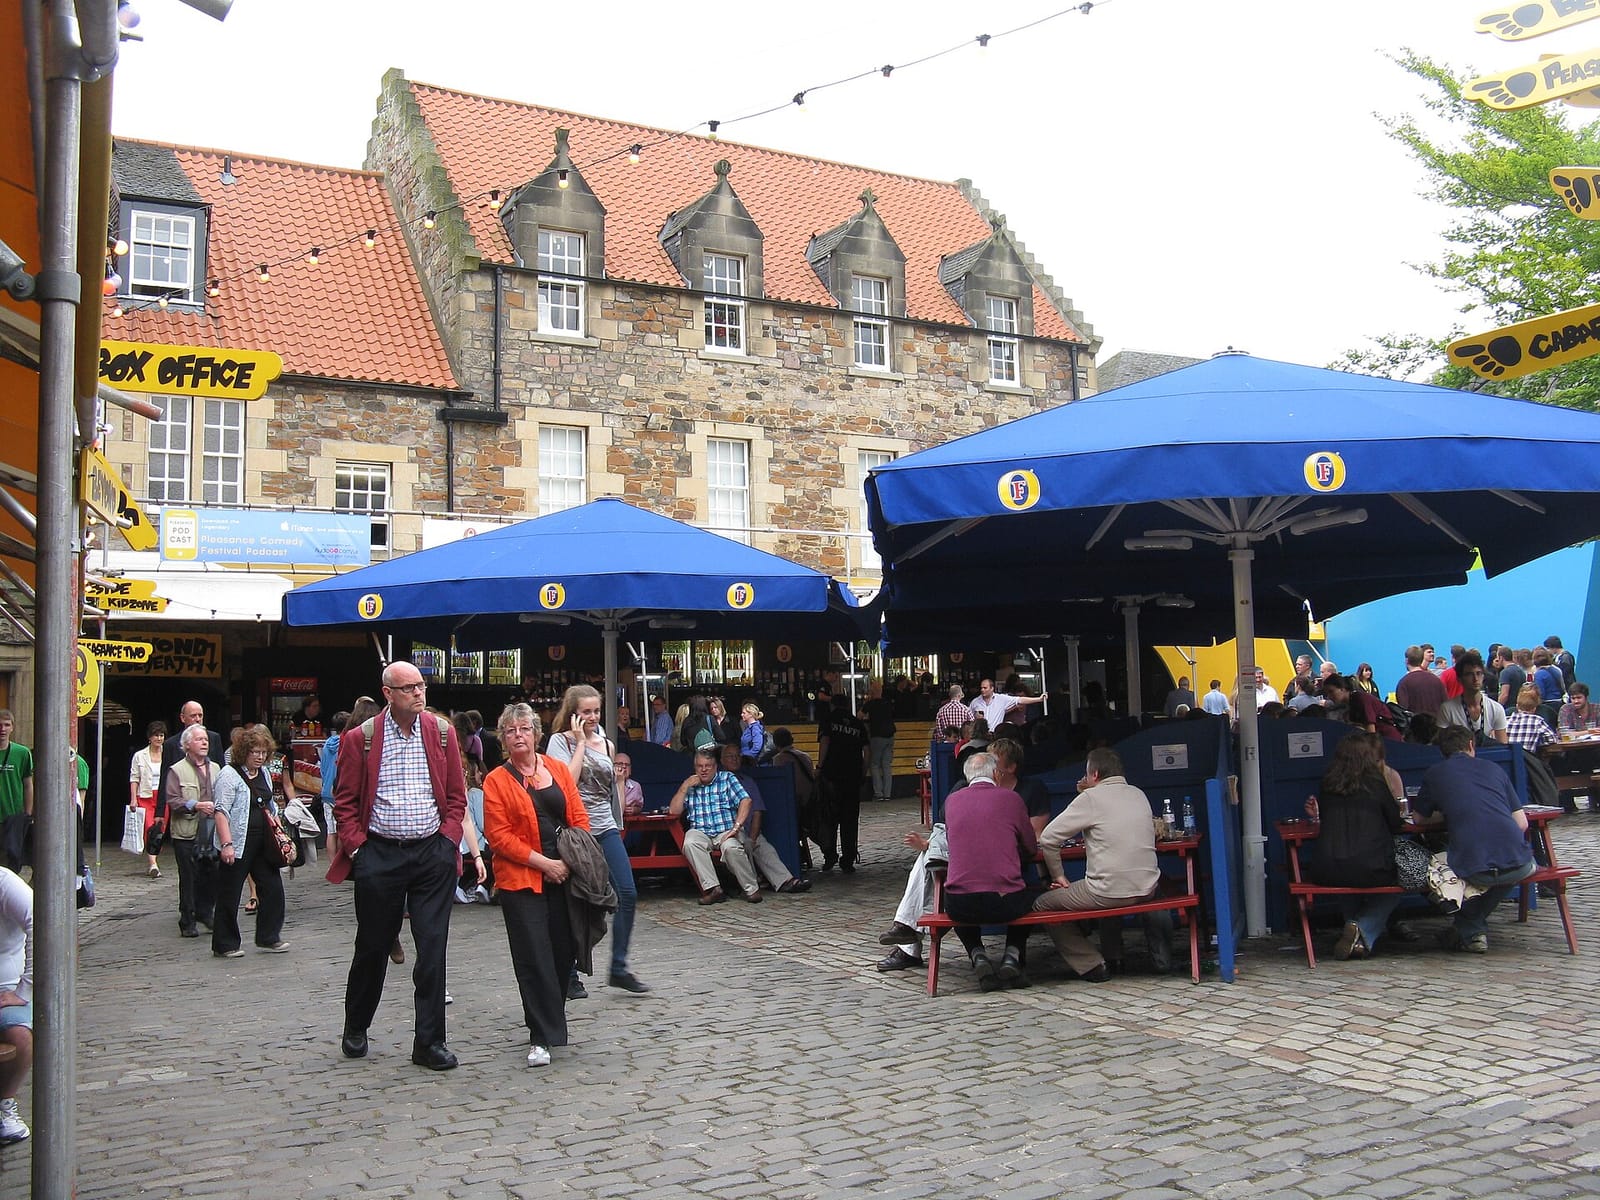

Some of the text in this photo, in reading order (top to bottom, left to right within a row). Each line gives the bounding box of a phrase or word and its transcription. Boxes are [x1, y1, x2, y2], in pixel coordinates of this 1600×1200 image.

[1551, 0, 1600, 17] BE
[99, 348, 256, 388] BOX OFFICE
[201, 535, 303, 548] Pleasance Comedy
[200, 546, 288, 556] Festival Podcast
[123, 646, 146, 660] TWO
